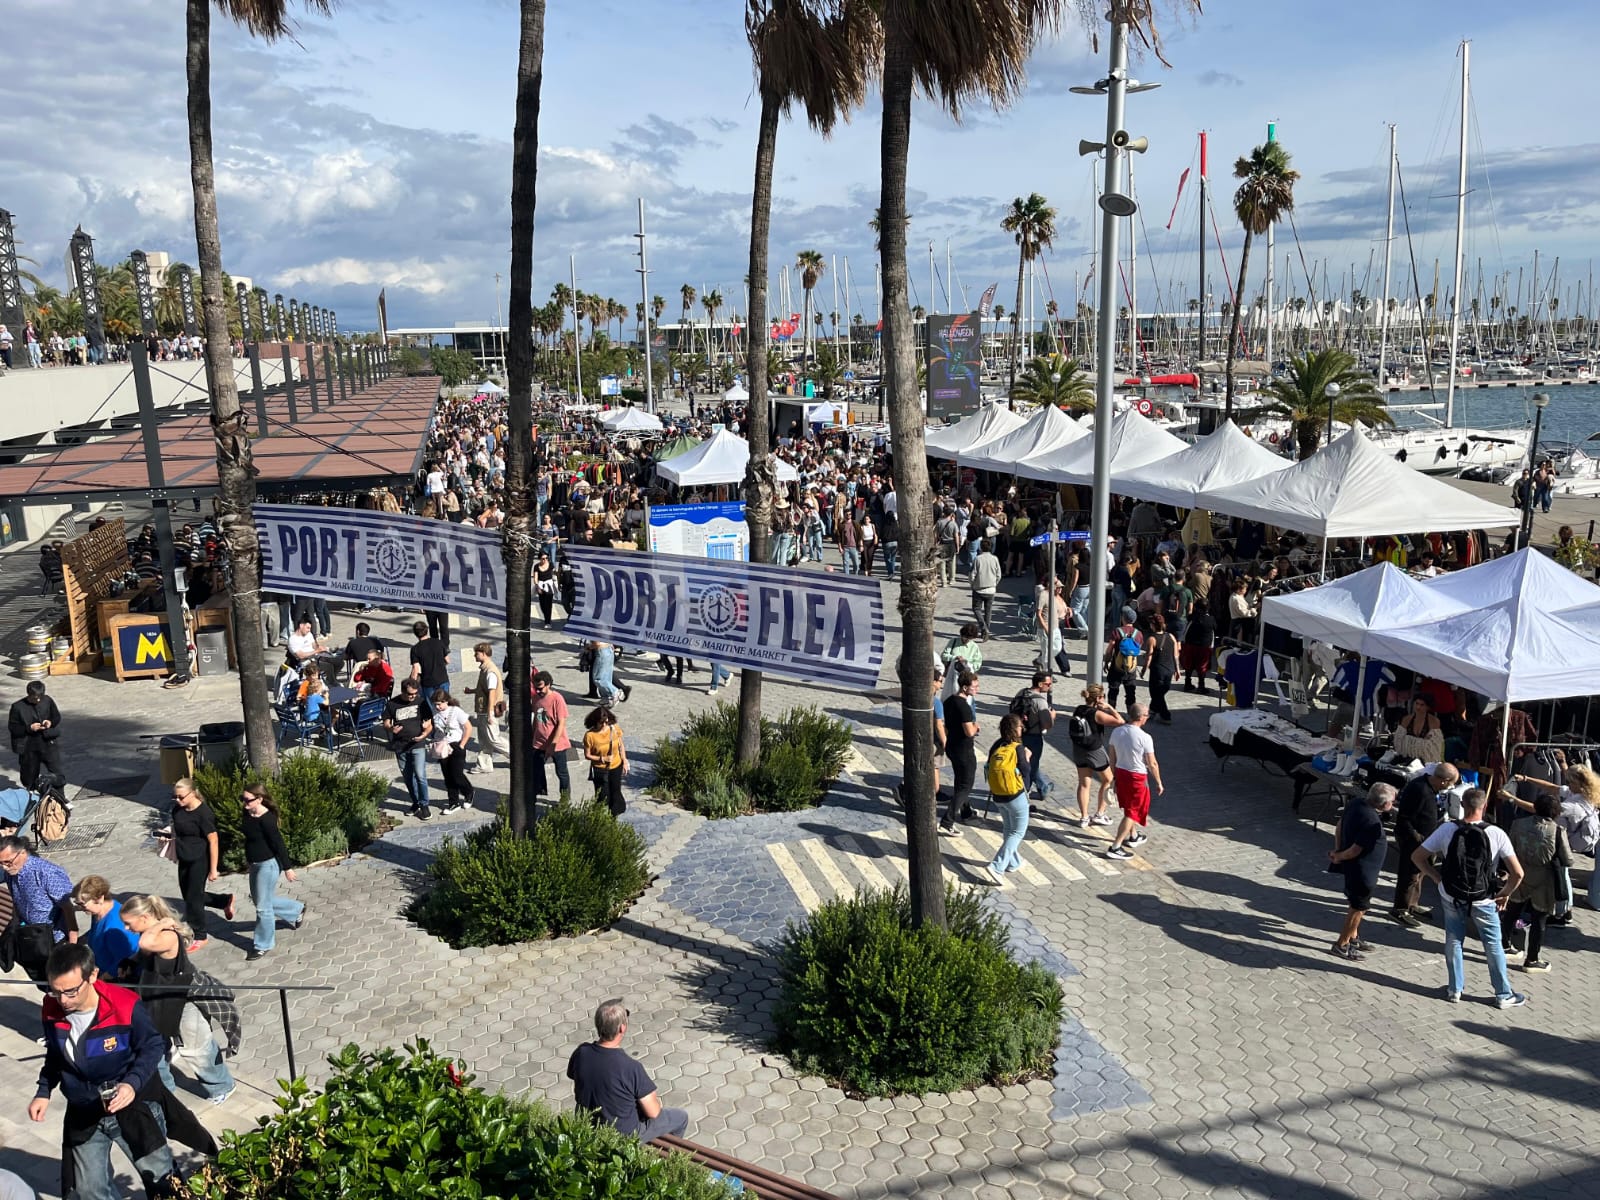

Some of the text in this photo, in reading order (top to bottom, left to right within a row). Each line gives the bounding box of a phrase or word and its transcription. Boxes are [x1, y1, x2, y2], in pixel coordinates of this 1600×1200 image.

[277, 524, 498, 600] PORT FLEA
[330, 580, 451, 602] MARVELLOUS MARITIME MARKET
[591, 566, 856, 661] PORT FLEA
[135, 631, 175, 664] M
[643, 630, 788, 662] MARVELLOUS MARITIME MARKET
